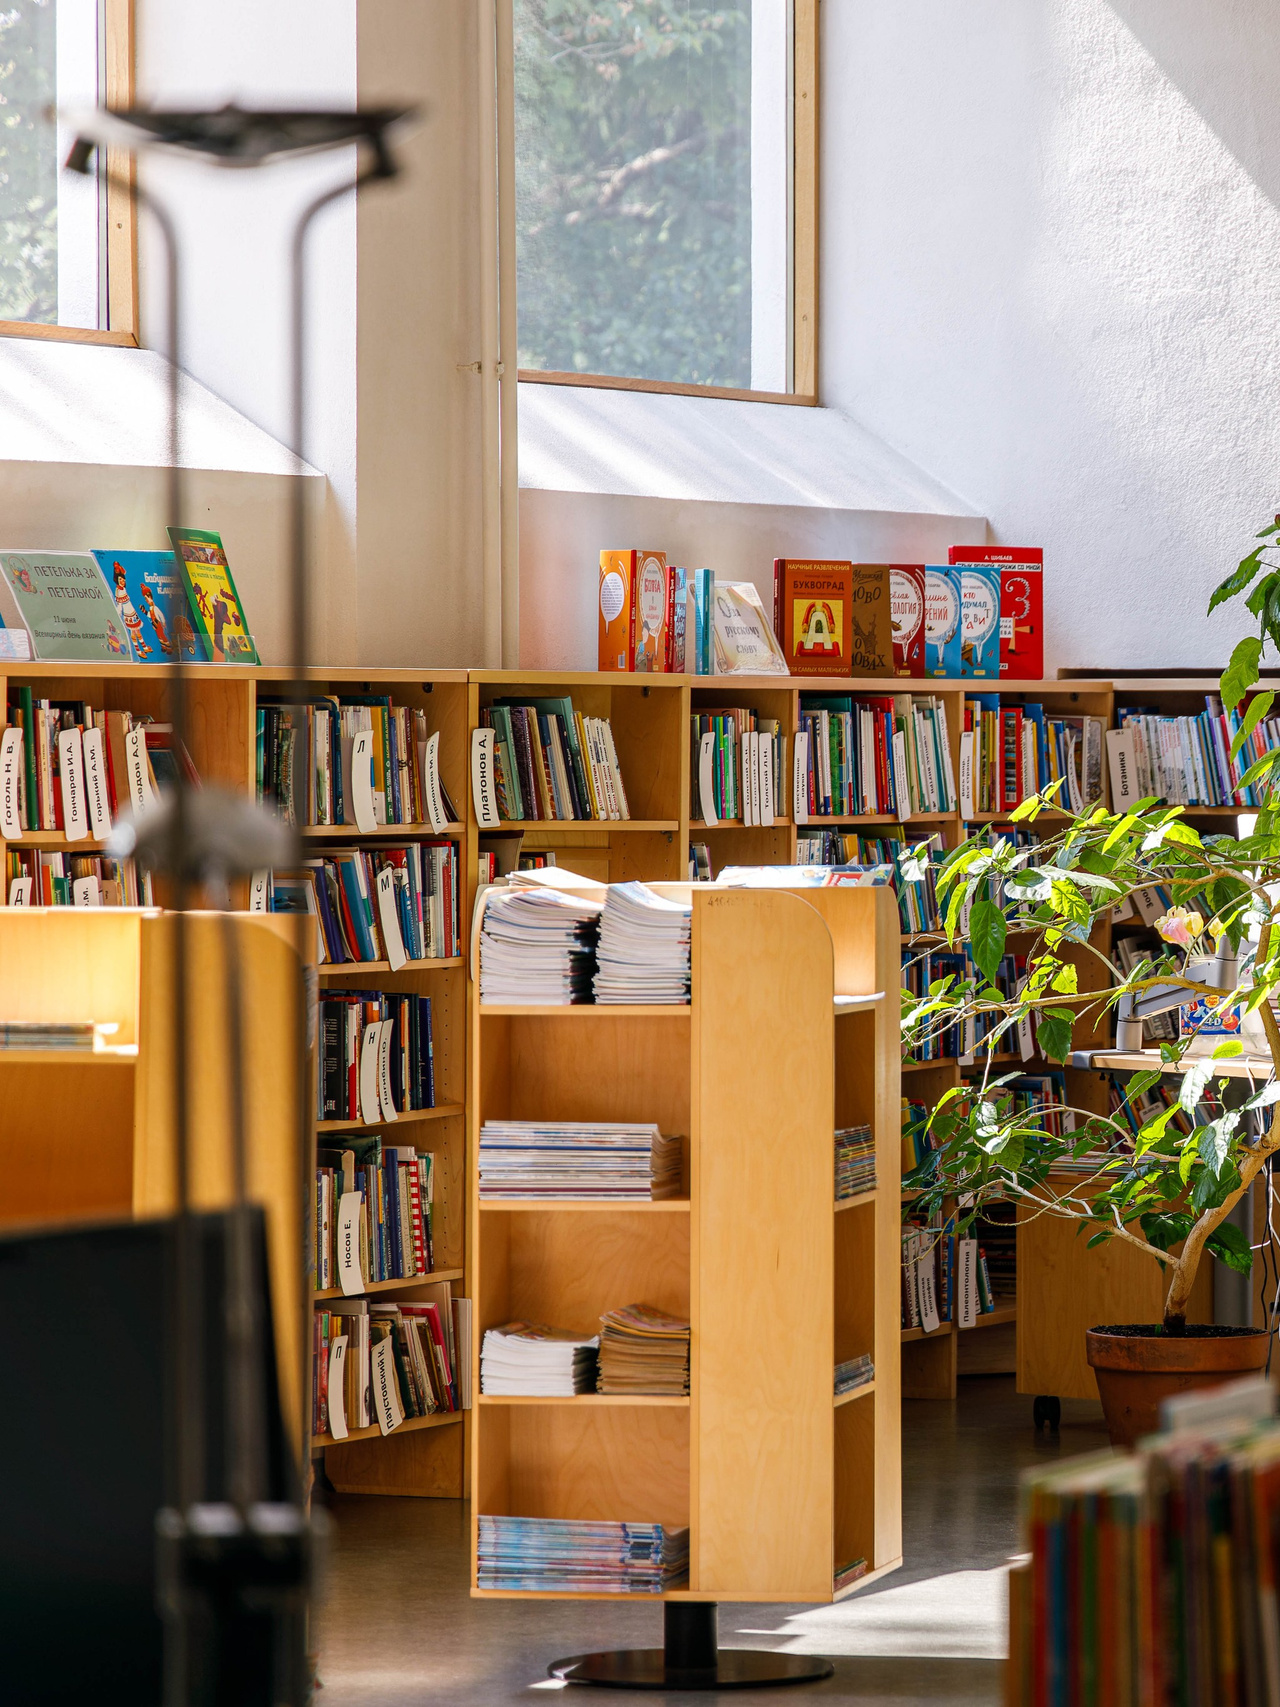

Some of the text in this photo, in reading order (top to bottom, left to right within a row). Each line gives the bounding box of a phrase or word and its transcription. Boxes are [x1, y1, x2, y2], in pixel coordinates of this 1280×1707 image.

[34, 566, 97, 579] ПЕТЕЛЬКА ЗА
[48, 586, 103, 600] ПЕТЕЛЬКОЙ
[793, 581, 844, 591] БУКВОГРАД
[34, 630, 66, 639] Всемирный
[724, 626, 760, 638] русскому
[6, 741, 14, 754] В.
[357, 740, 365, 754] Л
[5, 759, 12, 773] Н.
[478, 734, 492, 822] Платонов А.
[1119, 752, 1128, 796] Ботаника
[90, 745, 102, 822] Горький А.М.
[68, 768, 78, 822] Гончаров
[429, 770, 441, 824] Лермонтов
[381, 875, 390, 892] М
[368, 1032, 376, 1044] Н
[381, 1055, 389, 1105] Нагибин
[344, 1220, 352, 1268] Носов Е.
[335, 1346, 342, 1359] П
[377, 1358, 394, 1429] Паустовский
